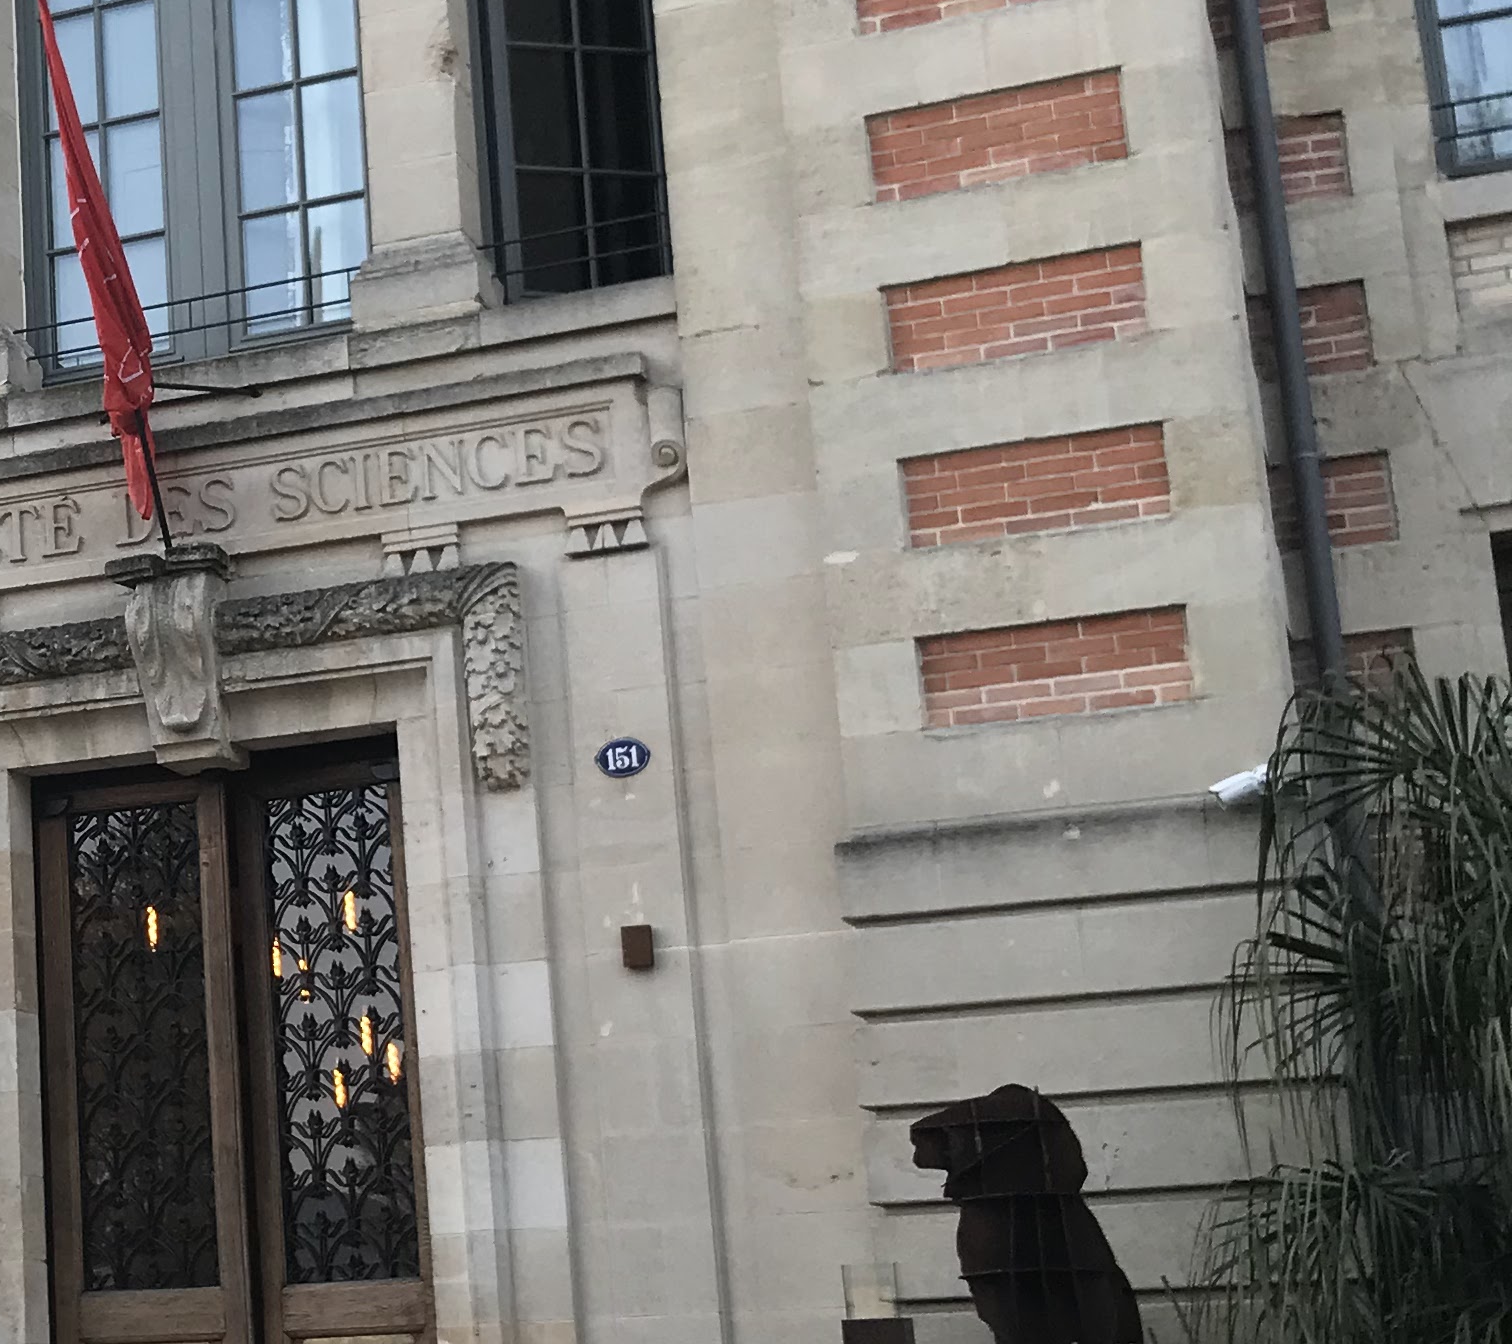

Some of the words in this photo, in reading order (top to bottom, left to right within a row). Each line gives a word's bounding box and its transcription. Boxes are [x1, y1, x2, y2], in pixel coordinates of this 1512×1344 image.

[114, 475, 238, 550] DES
[274, 416, 607, 523] SCIENCES
[605, 744, 640, 771] 151
